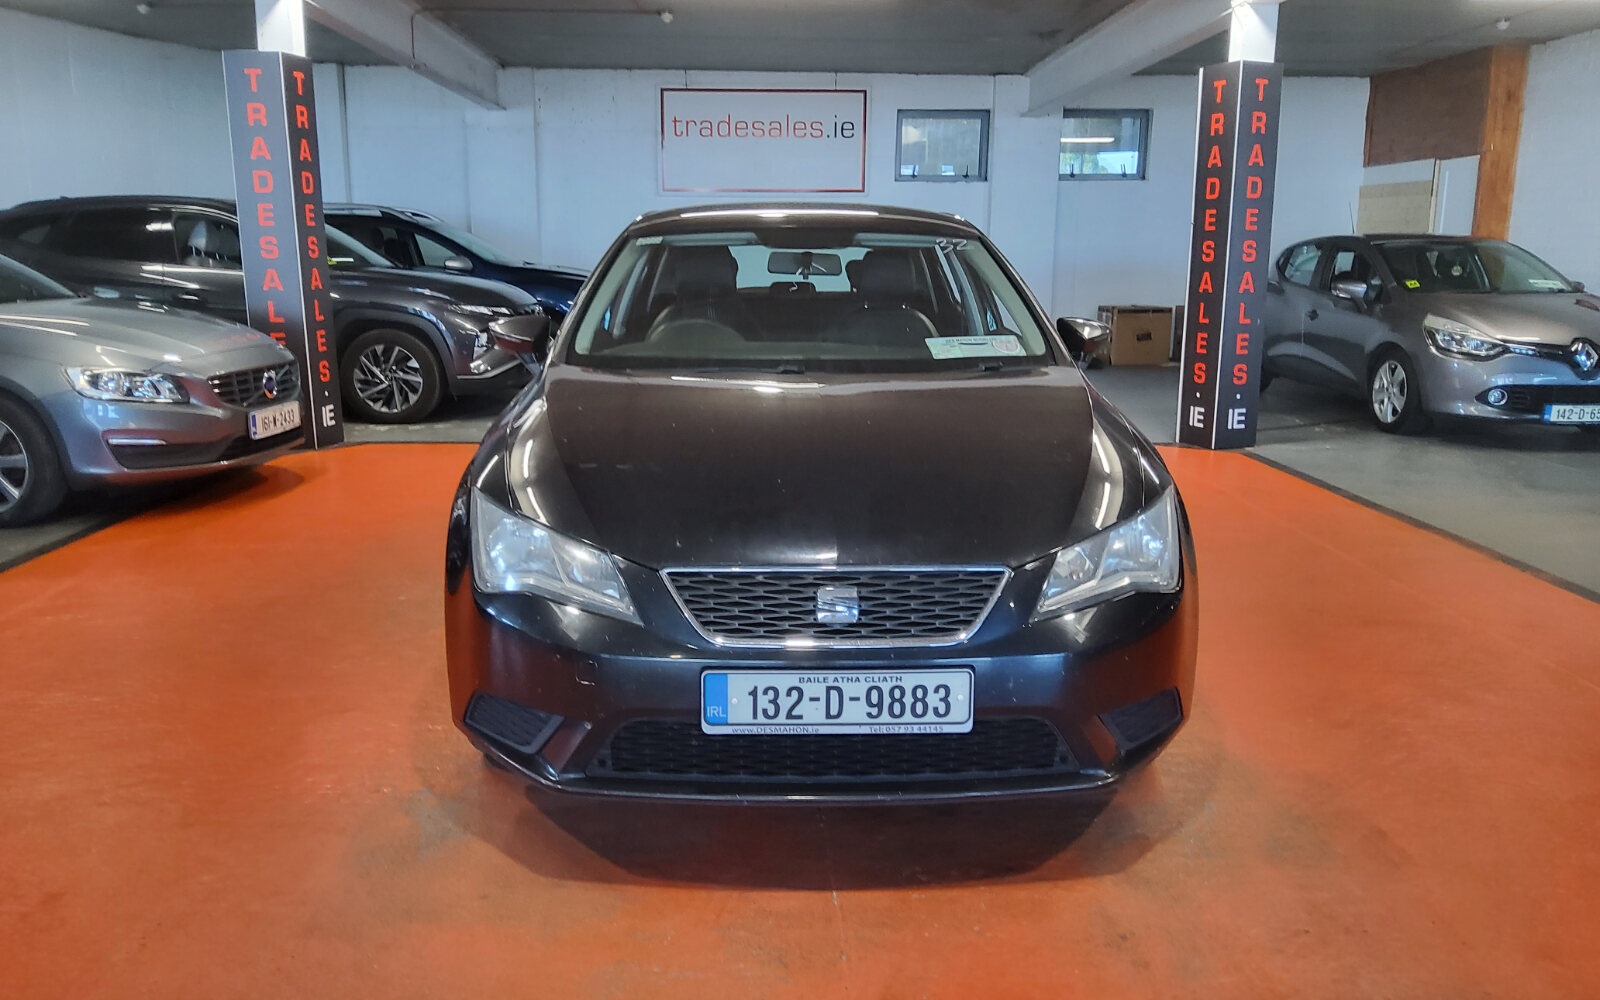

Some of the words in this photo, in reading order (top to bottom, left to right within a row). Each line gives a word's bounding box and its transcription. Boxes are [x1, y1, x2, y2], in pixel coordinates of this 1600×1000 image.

[671, 113, 855, 139] tradesales.ie
[798, 676, 829, 684] BAILE
[747, 683, 951, 720] 132-D-9883
[706, 705, 726, 718] IRL
